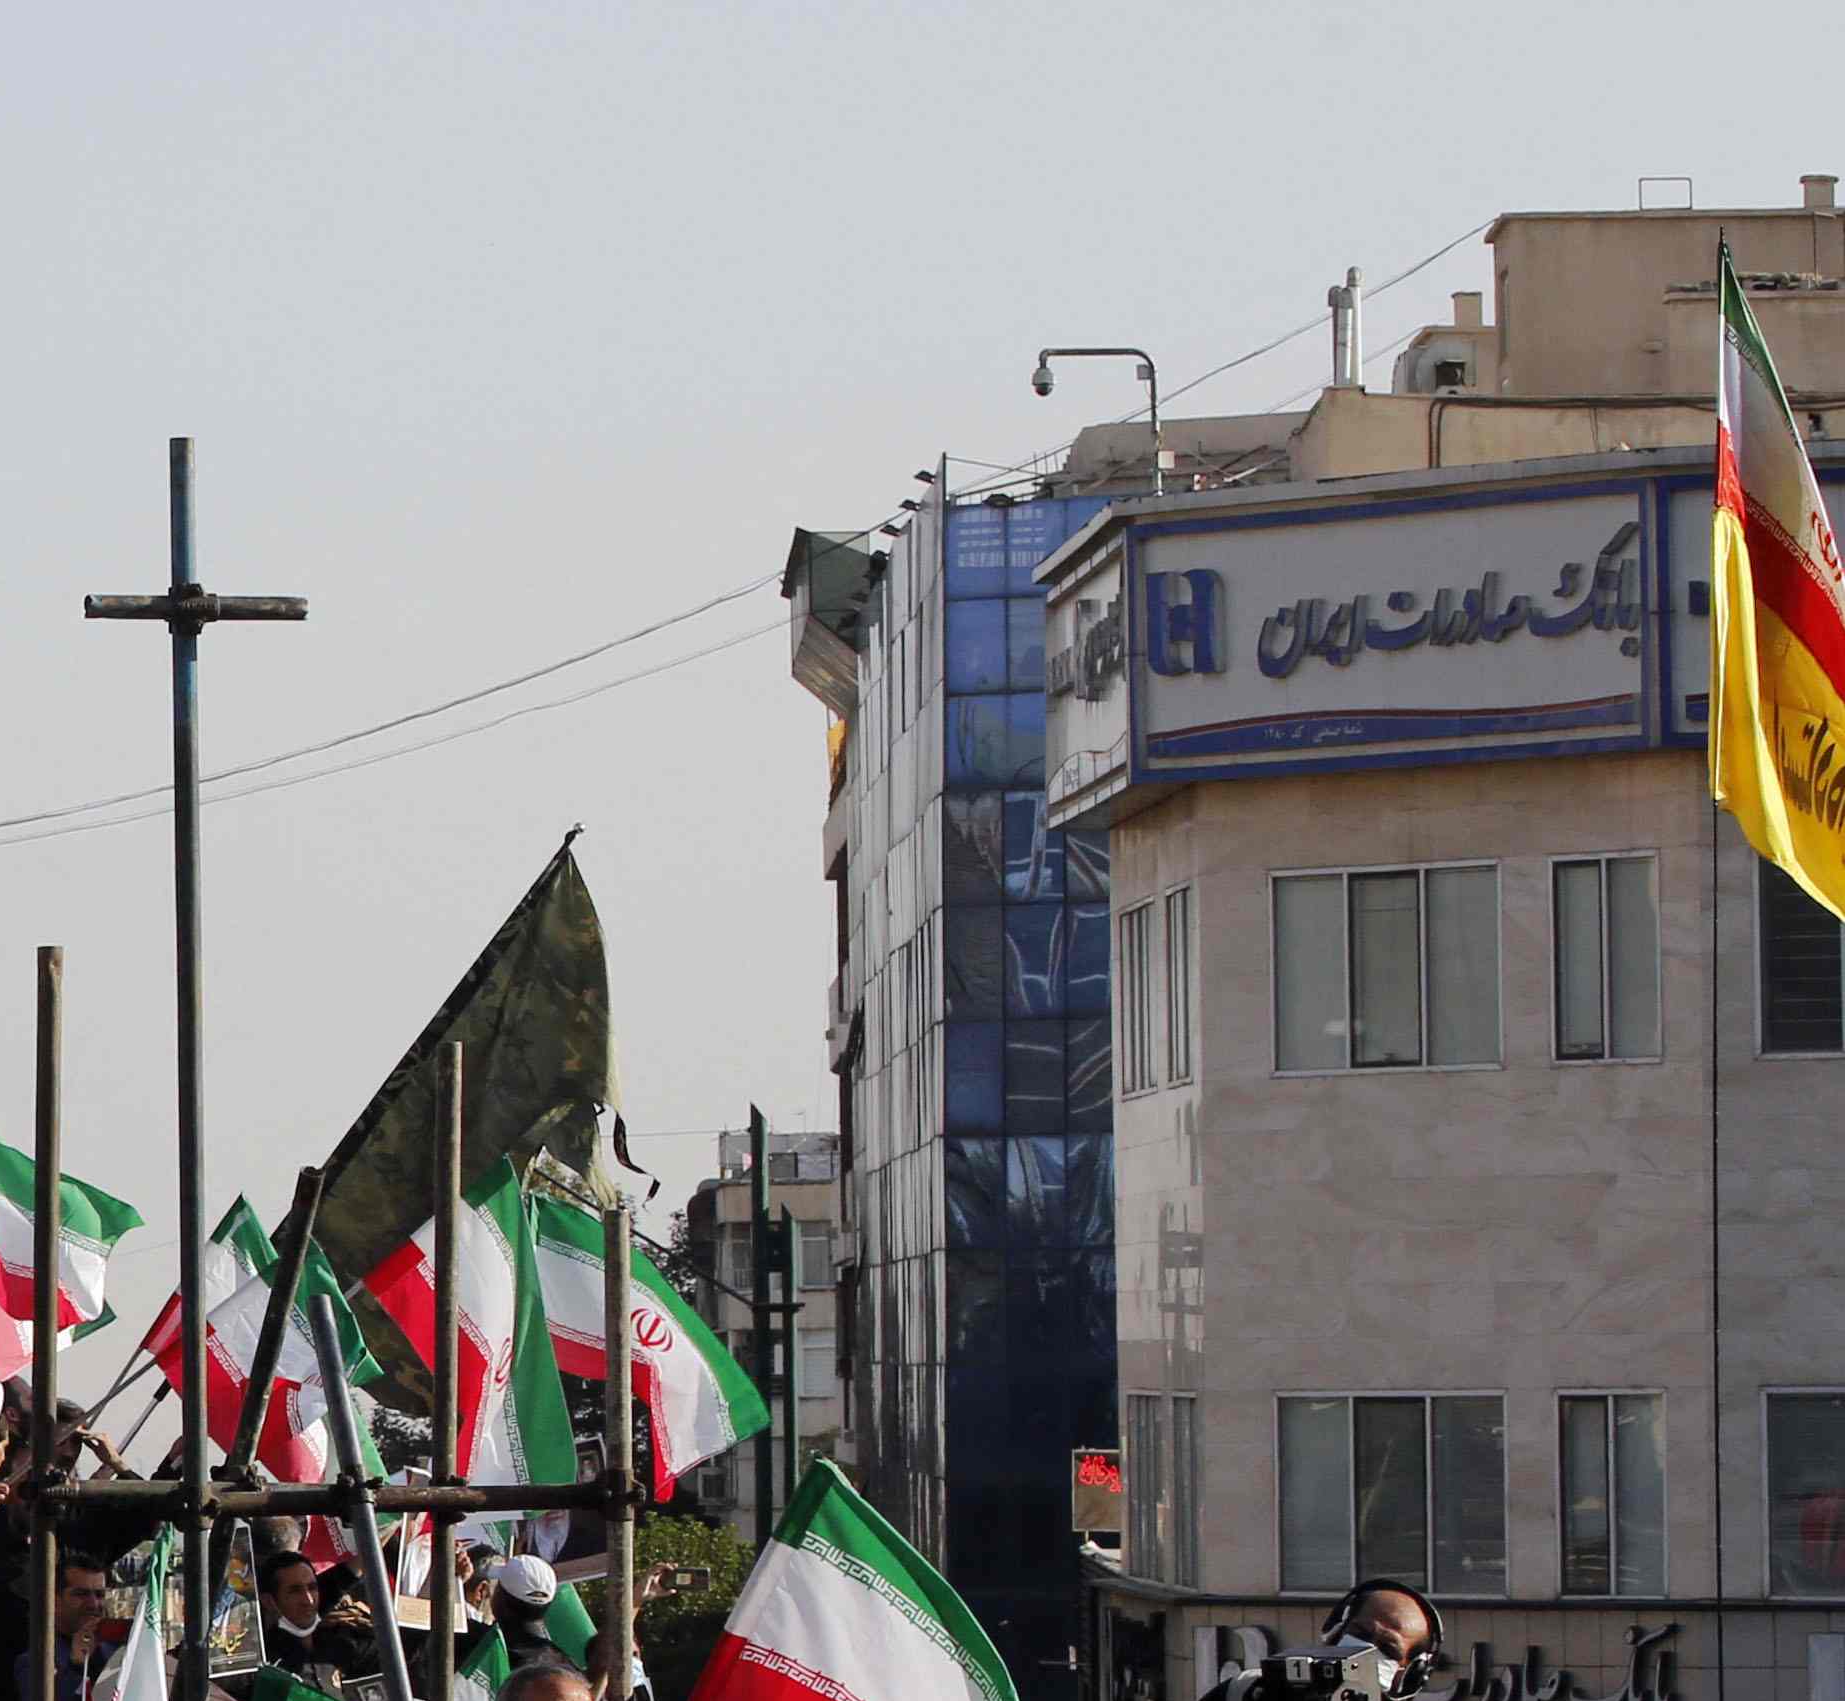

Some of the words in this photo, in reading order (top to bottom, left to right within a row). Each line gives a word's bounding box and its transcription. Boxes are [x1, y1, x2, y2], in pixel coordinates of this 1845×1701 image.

[1366, 570, 1531, 650] صادرات
[1527, 521, 1640, 657] بانک
[1257, 594, 1368, 678] ایران
